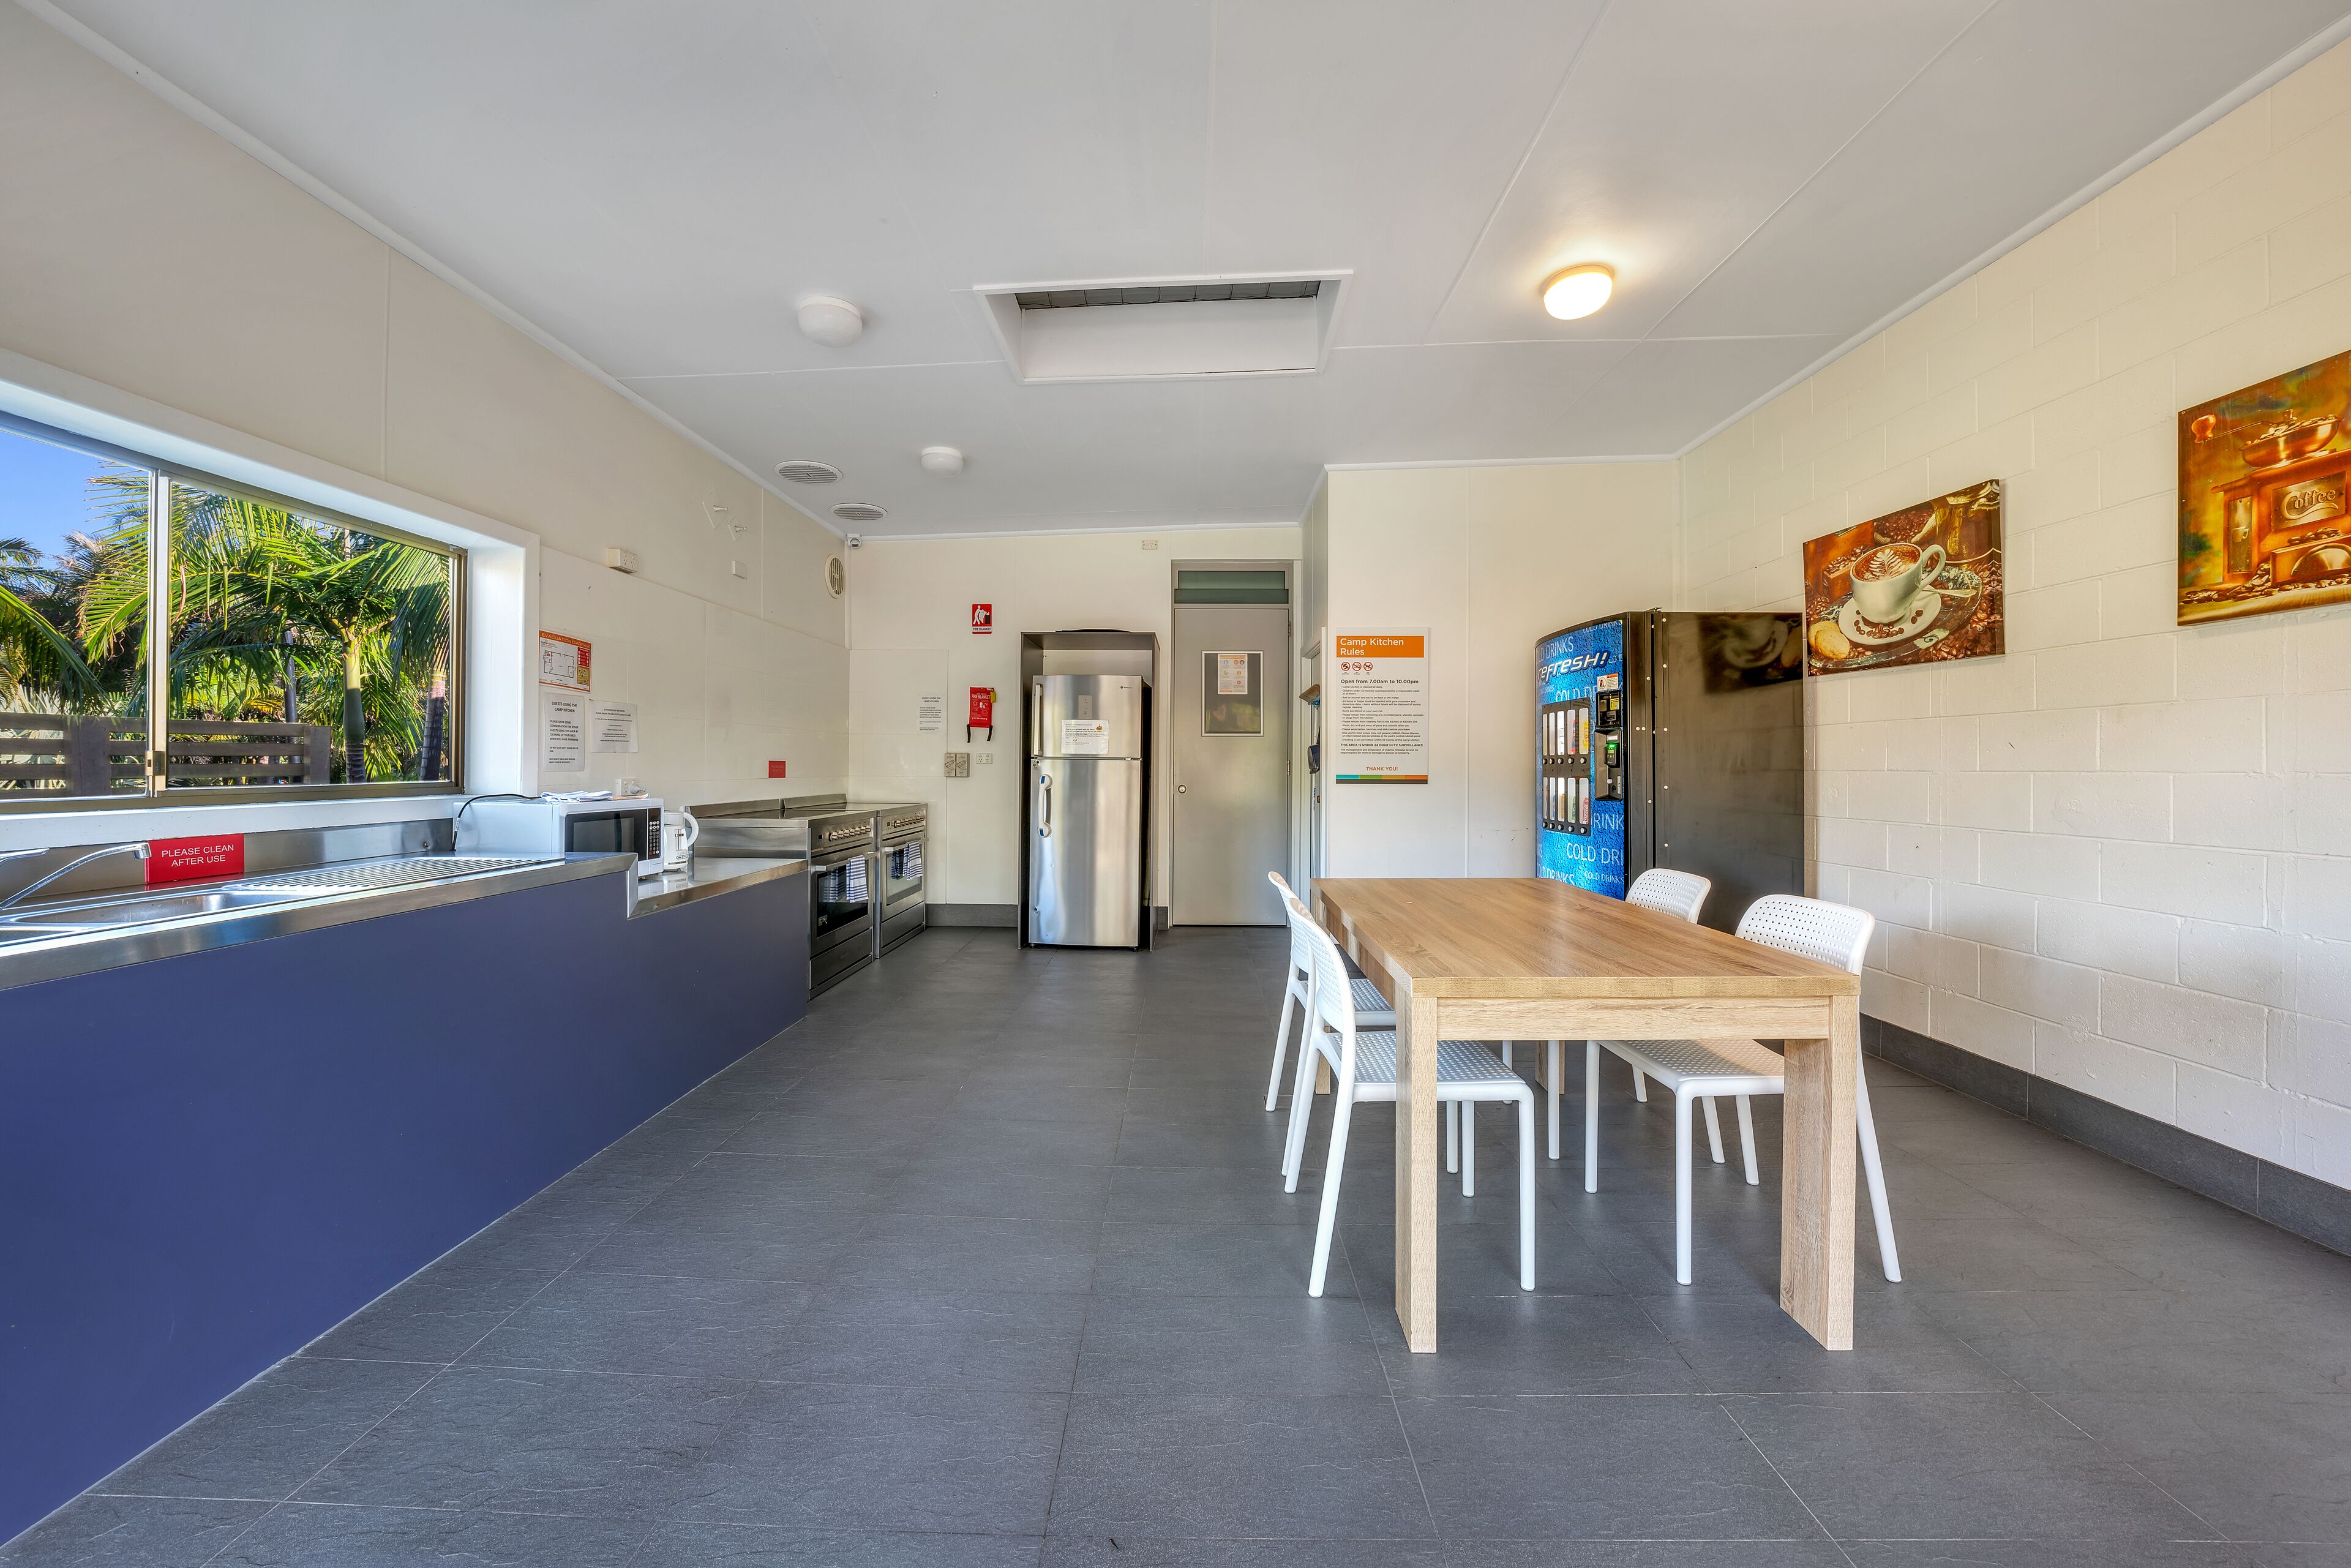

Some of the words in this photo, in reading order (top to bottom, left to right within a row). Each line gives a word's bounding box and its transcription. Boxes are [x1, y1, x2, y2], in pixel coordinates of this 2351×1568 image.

[2281, 489, 2339, 520] Coffee
[542, 633, 572, 643] EVACUATION
[1340, 638, 1367, 646] Camp
[1546, 636, 1574, 660] DRINKS
[161, 847, 201, 857] PLEASE
[203, 844, 234, 854] CLEAN
[1567, 843, 1596, 862] COLD
[171, 856, 204, 867] AFTER
[207, 855, 225, 863] USE
[1585, 870, 1599, 880] COLD
